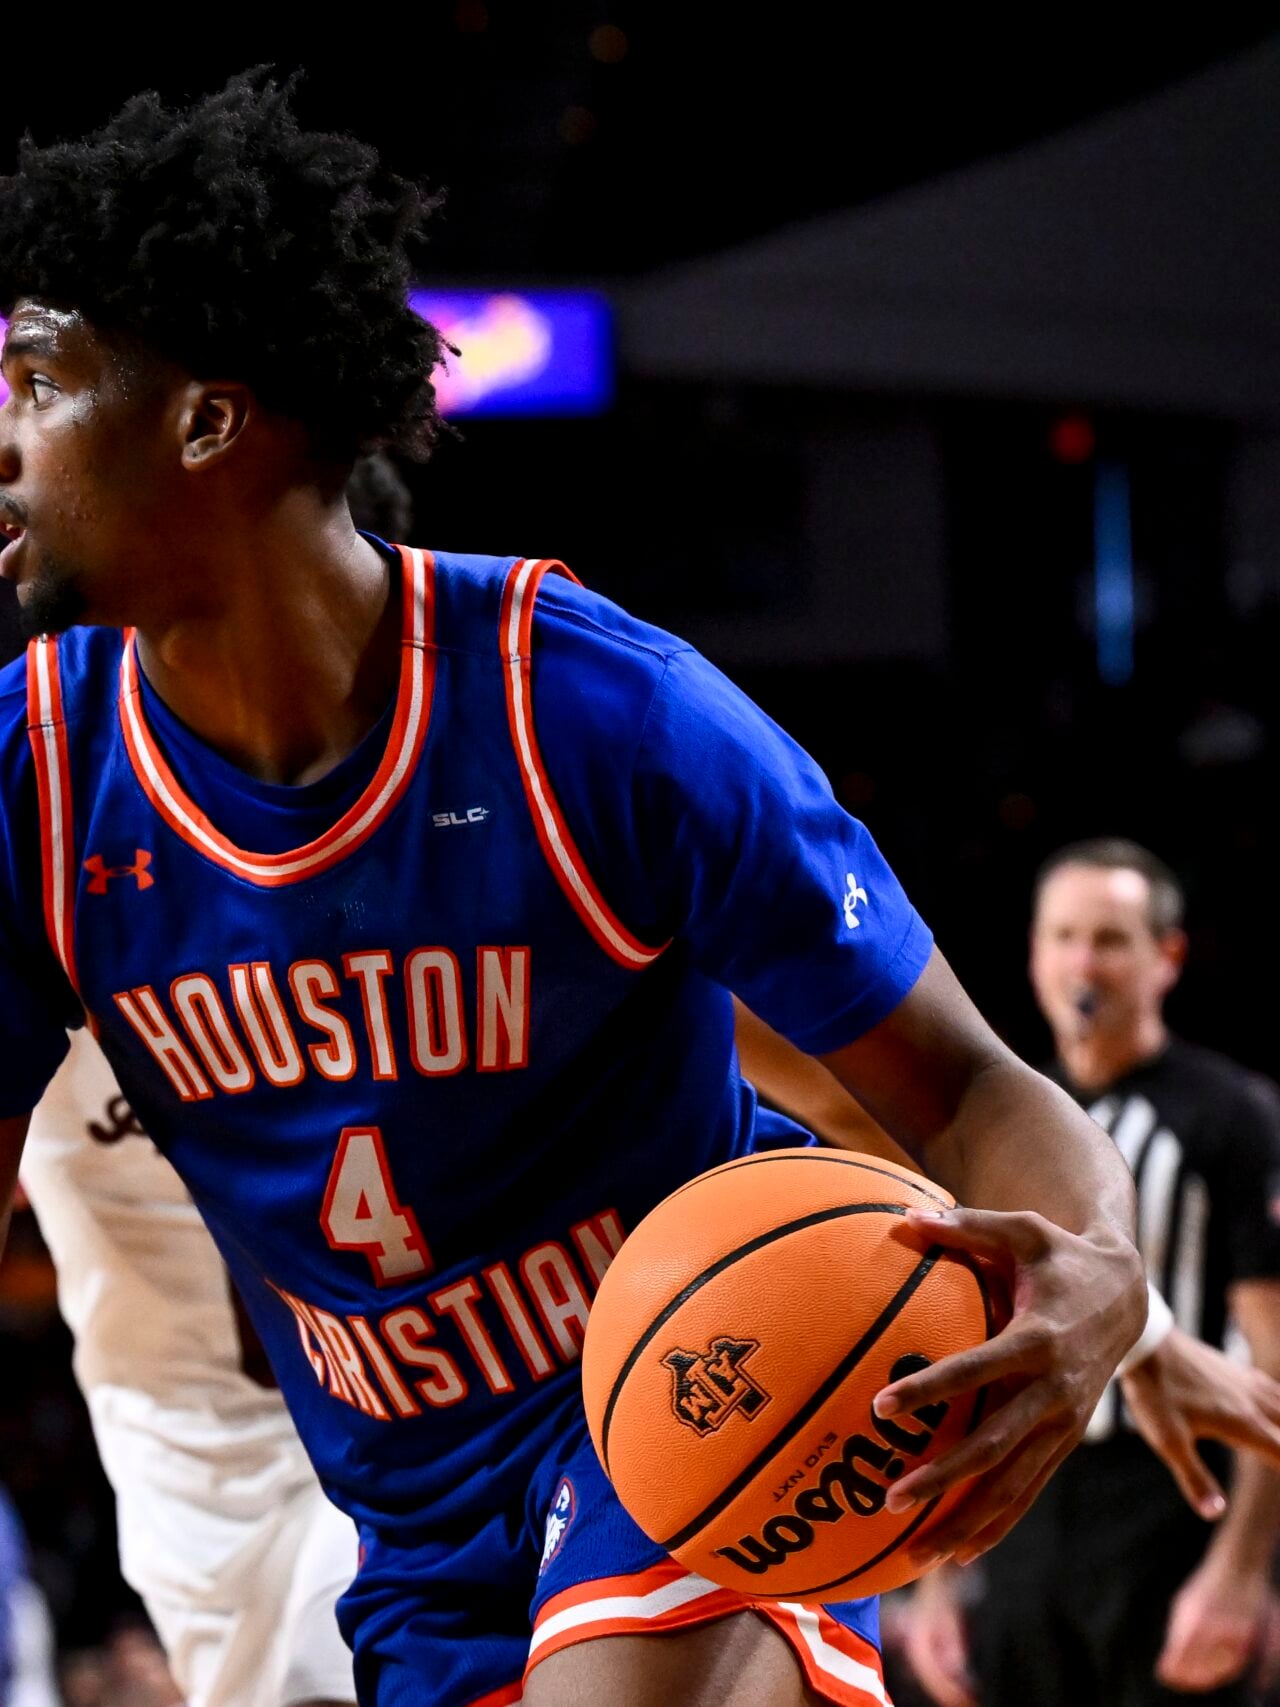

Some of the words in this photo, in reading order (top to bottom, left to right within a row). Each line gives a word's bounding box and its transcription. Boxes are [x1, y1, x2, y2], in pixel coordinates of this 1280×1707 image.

[431, 806, 487, 828] SLC
[113, 945, 531, 1101] HOUSTON
[319, 1126, 434, 1289] 4
[714, 1352, 950, 1575] Wilson
[771, 1468, 806, 1503] NXT
[804, 1430, 839, 1468] EVO
